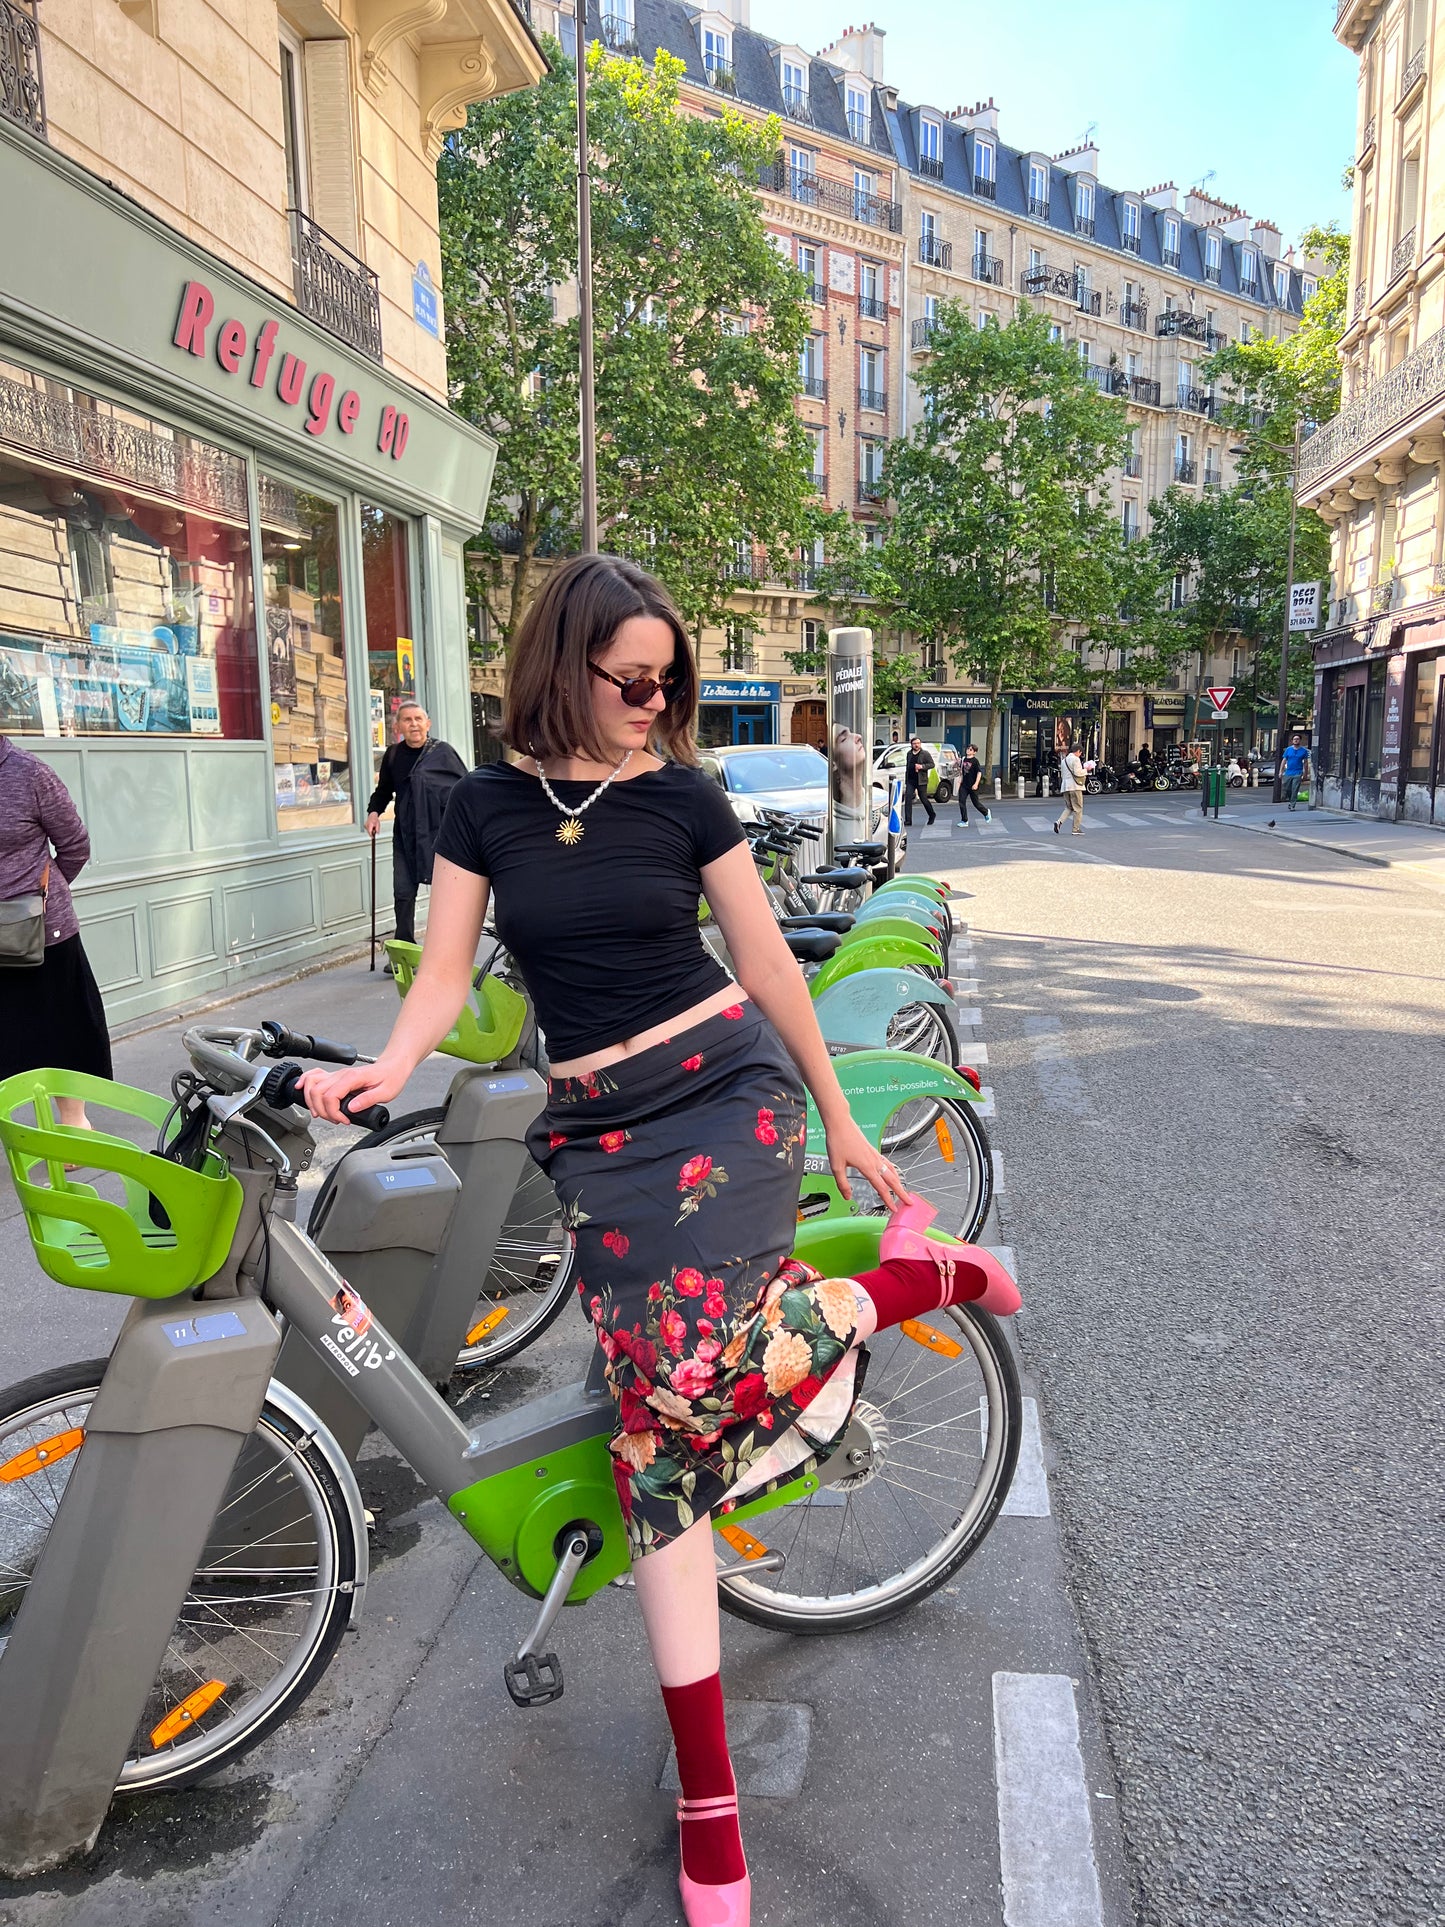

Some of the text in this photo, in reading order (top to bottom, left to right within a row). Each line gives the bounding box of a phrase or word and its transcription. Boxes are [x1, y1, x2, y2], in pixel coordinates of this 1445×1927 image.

[174, 280, 410, 461] Refuge BD
[1293, 587, 1316, 598] DECO
[1293, 597, 1314, 607] BOIS
[703, 685, 771, 697] Le Silence de la Rue
[920, 696, 963, 704] CABINET
[866, 1085, 885, 1094] tous
[886, 1082, 899, 1092] les
[900, 1079, 938, 1092] possibles
[803, 1159, 824, 1171] 281
[174, 1328, 186, 1338] 11
[322, 1337, 357, 1374] MÉTROPOLE
[319, 1474, 336, 1496] PLUS
